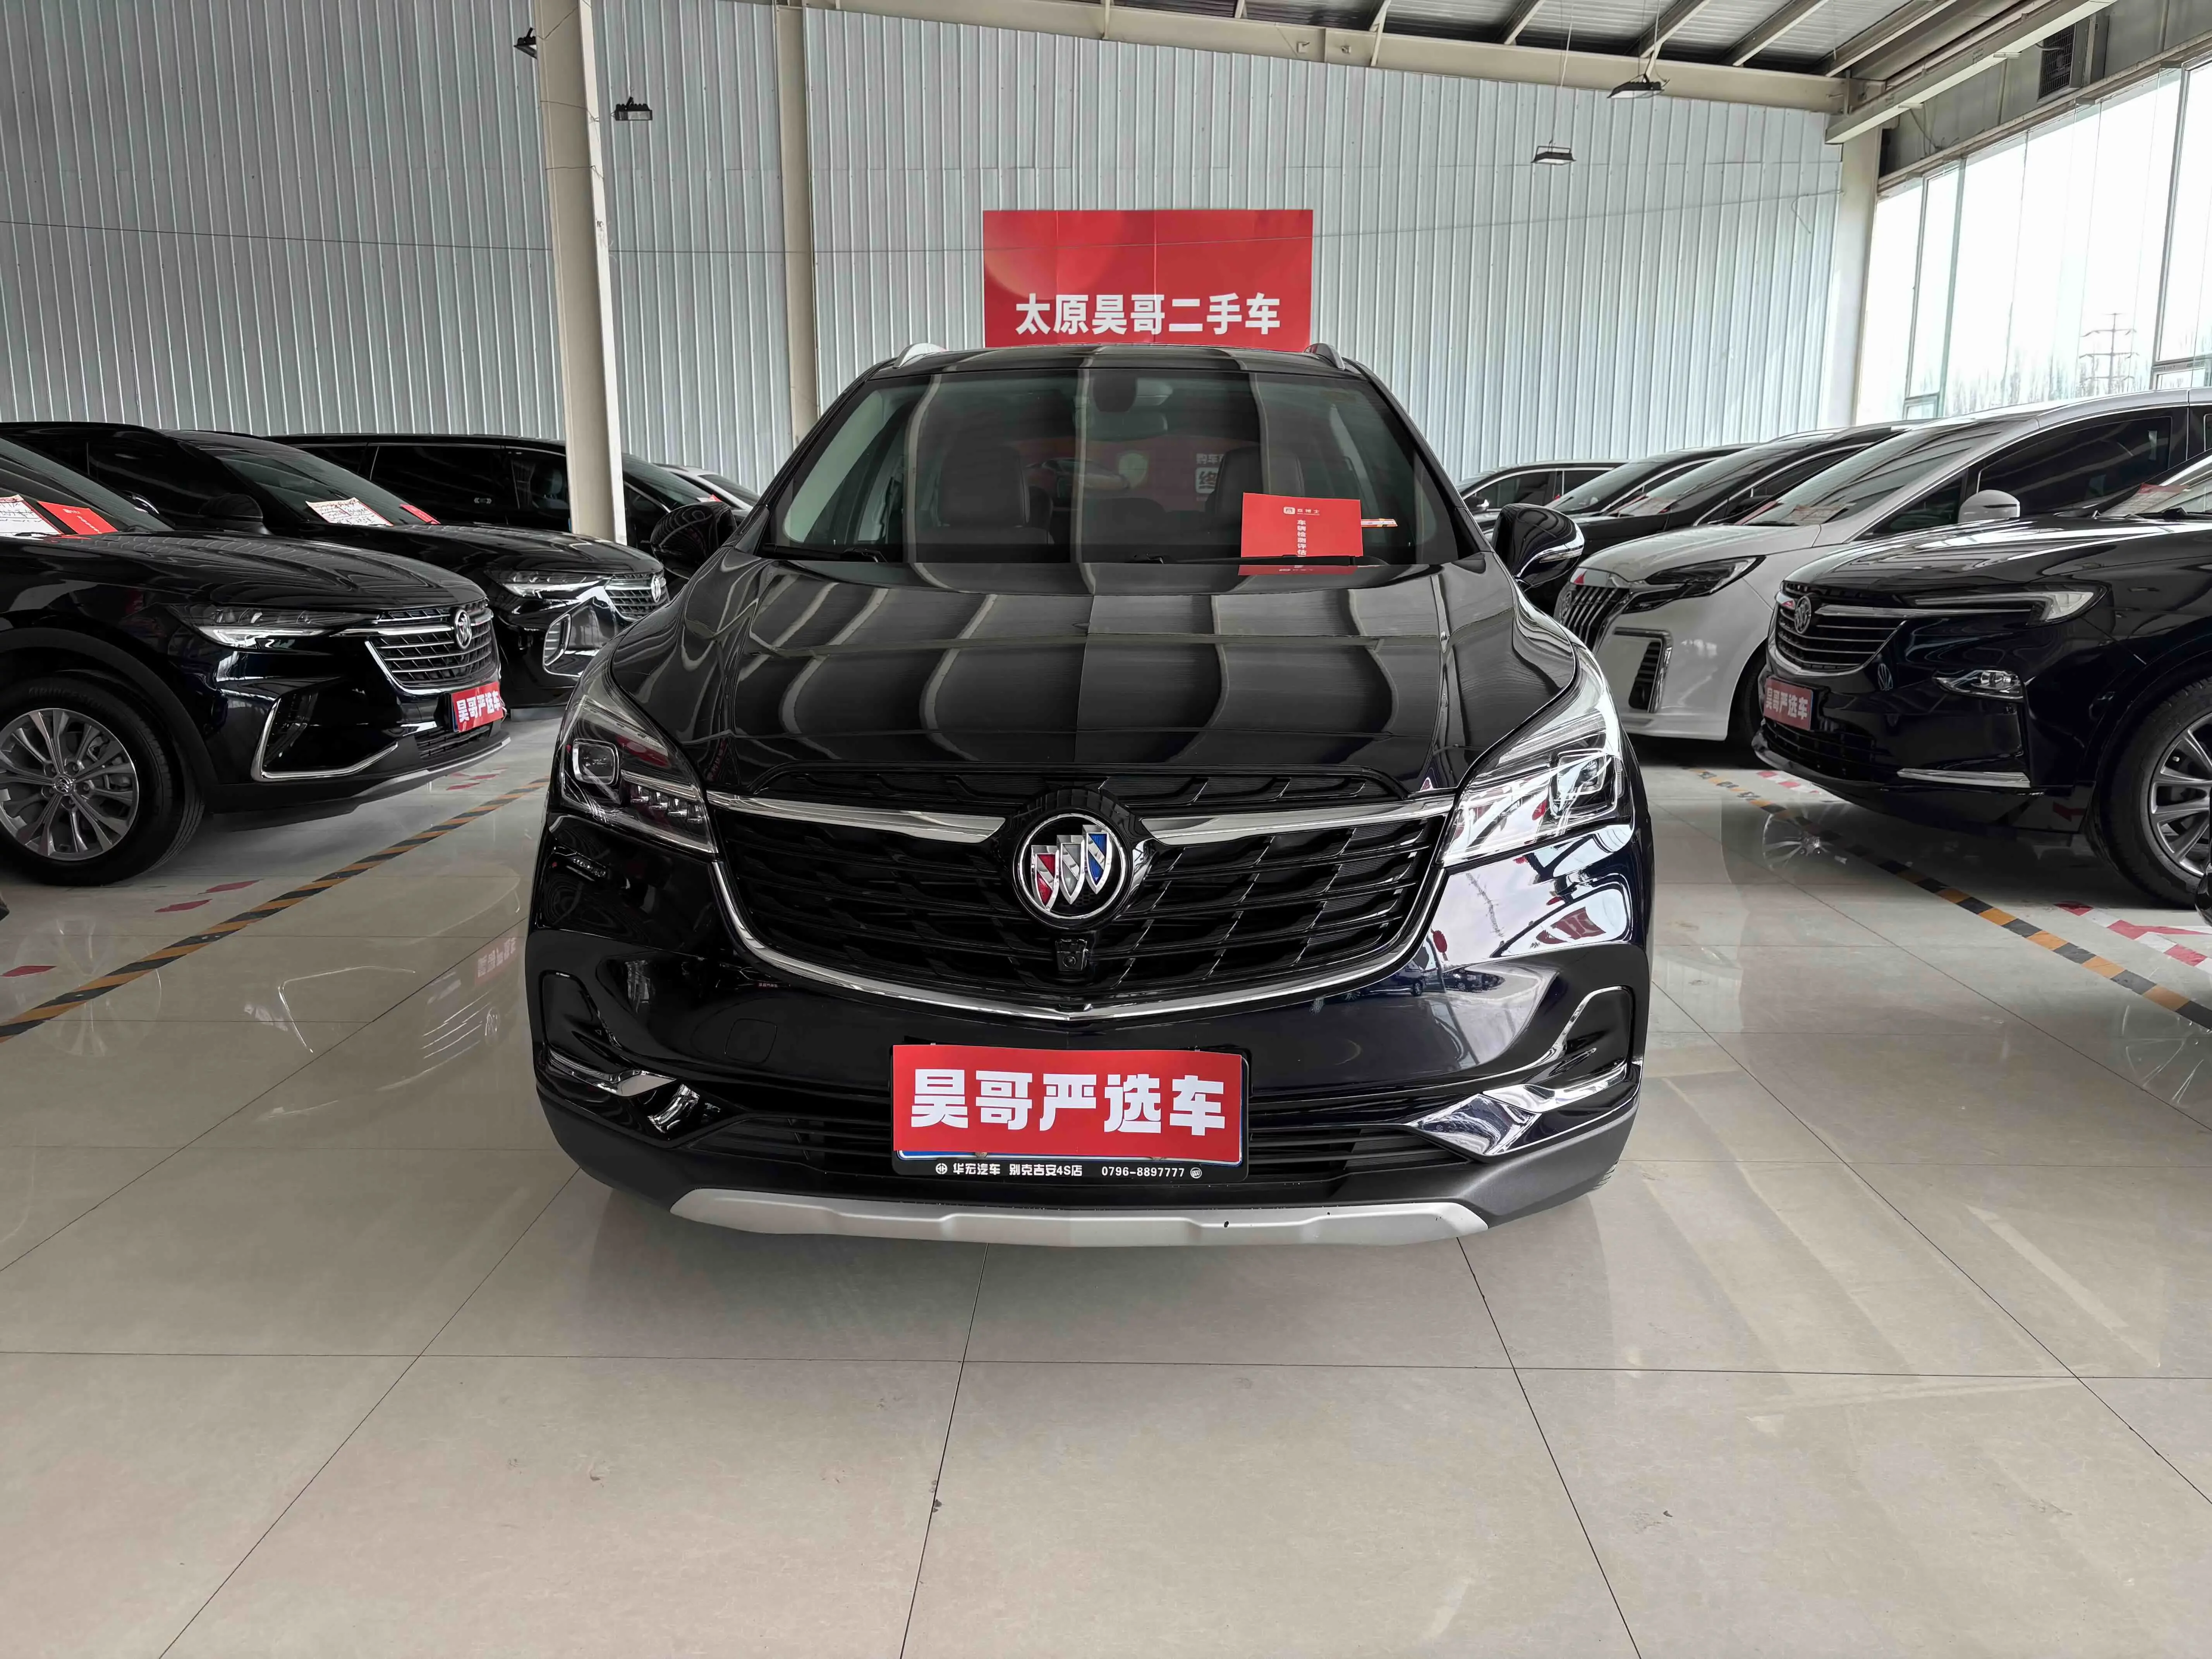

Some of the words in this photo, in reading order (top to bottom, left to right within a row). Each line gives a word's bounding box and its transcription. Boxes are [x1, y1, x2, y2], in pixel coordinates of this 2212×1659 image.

[1015, 292, 1281, 335] 太原昊哥二手车
[1297, 520, 1307, 557] 车辆检测评估
[456, 690, 501, 723] 昊哥严选车
[1766, 687, 1808, 720] 昊哥严选车
[911, 1069, 1225, 1136] 昊哥严选车
[953, 1163, 1000, 1175] 华宏汽车
[1009, 1163, 1082, 1176] 别克吉安4S店
[1101, 1166, 1185, 1177] 0796-8897777
